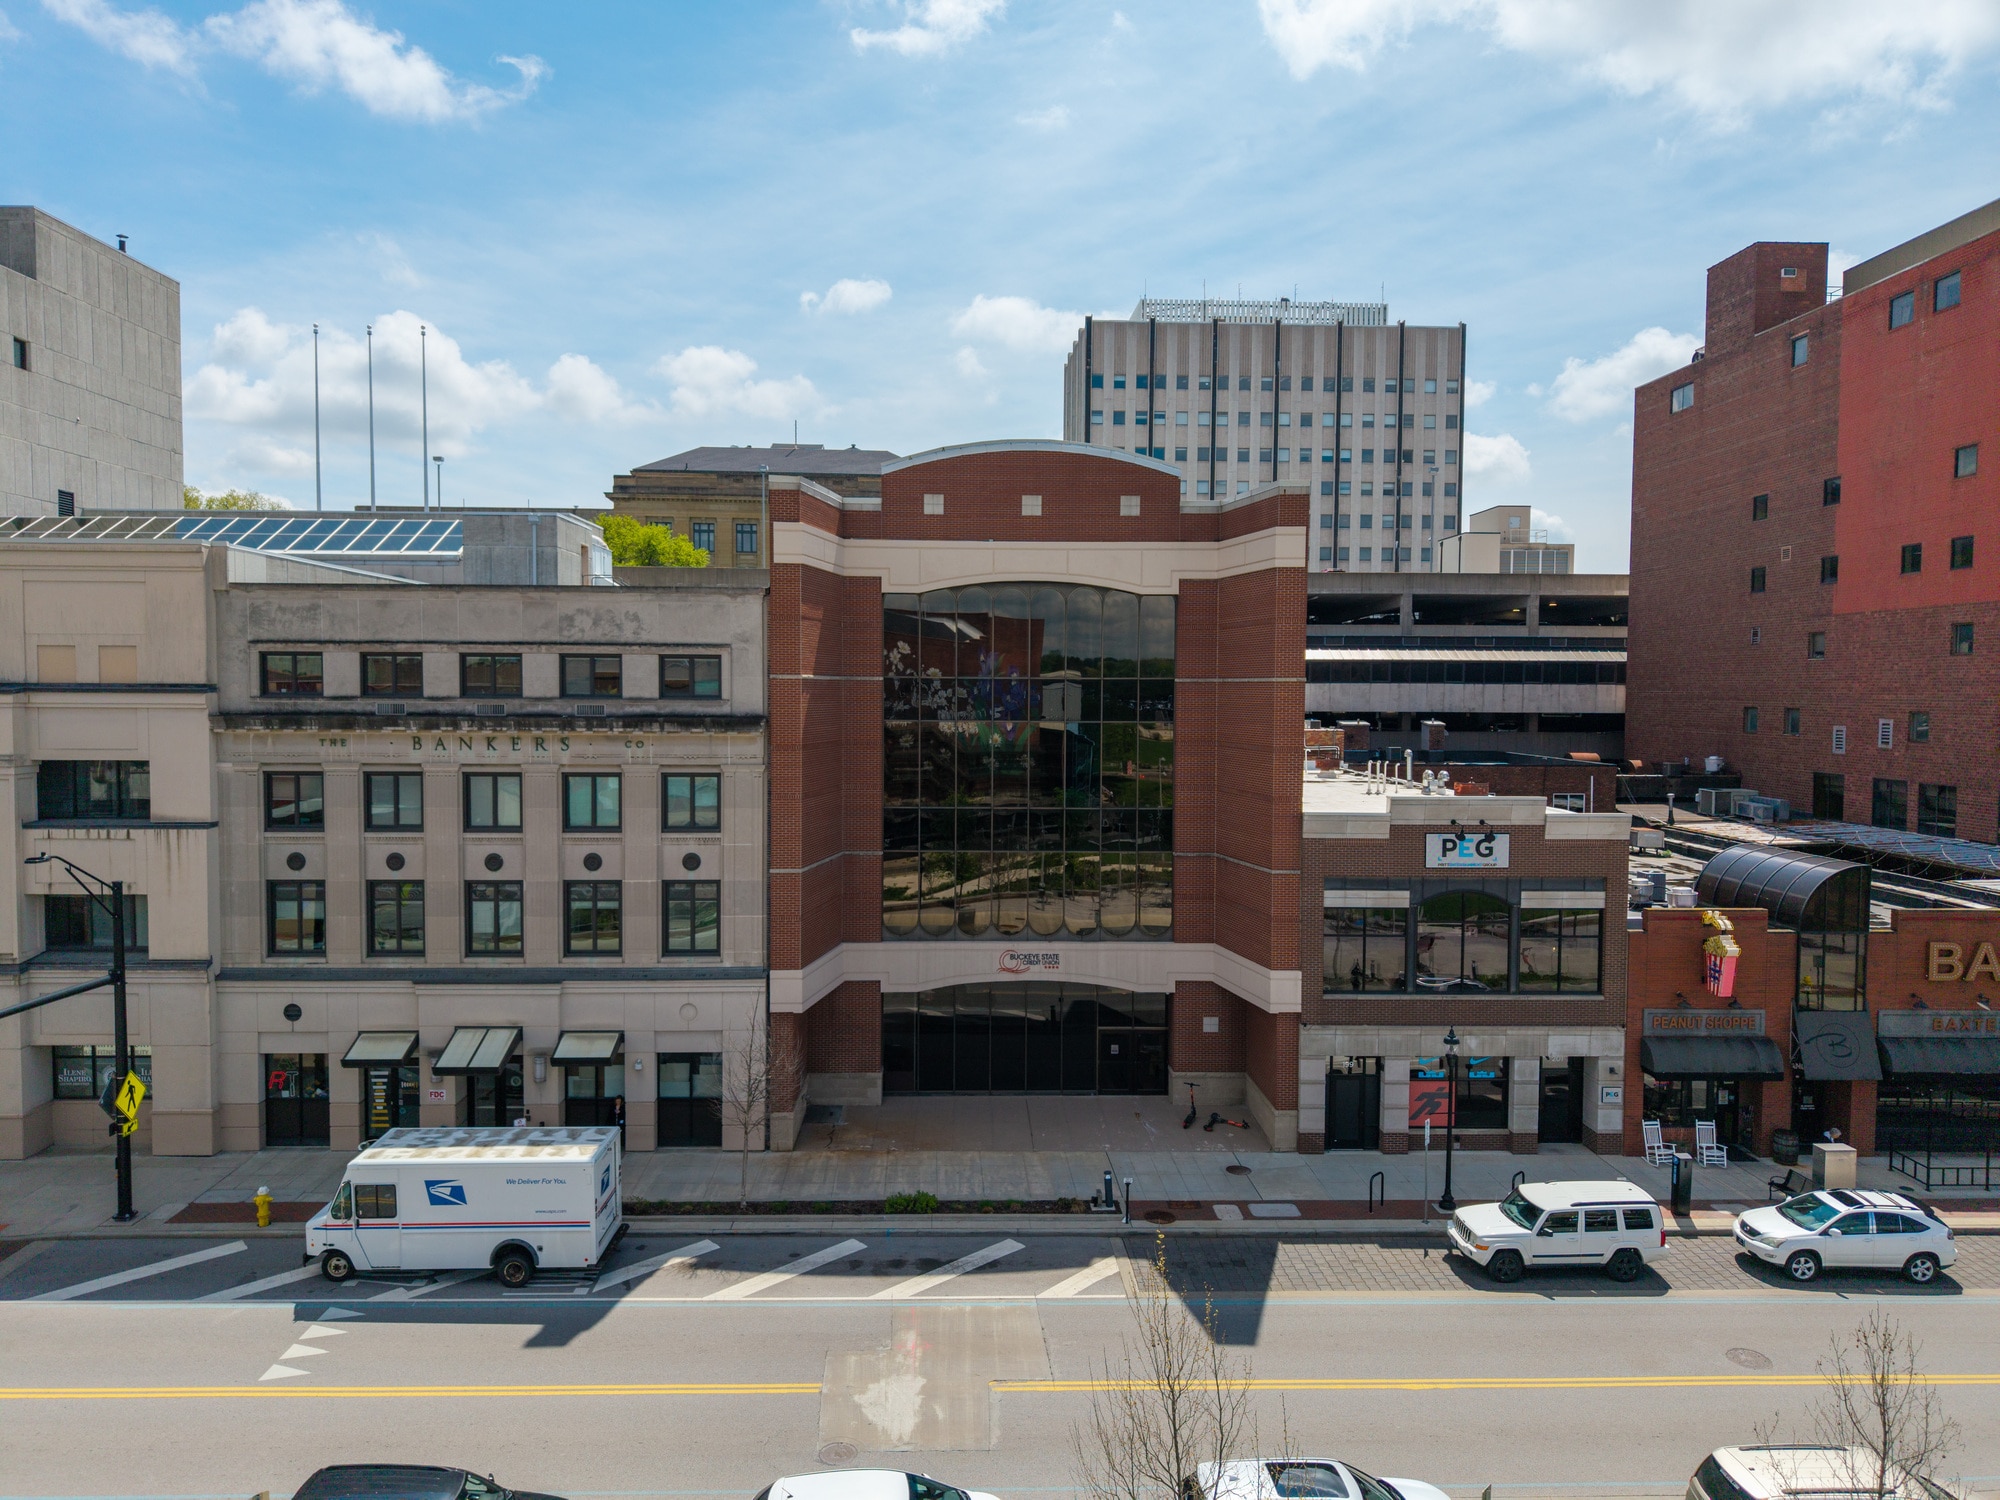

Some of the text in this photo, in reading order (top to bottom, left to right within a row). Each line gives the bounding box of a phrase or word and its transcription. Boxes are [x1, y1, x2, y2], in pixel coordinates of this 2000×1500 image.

[319, 738, 347, 747] THE
[412, 736, 570, 751] BANKERS
[1441, 838, 1494, 858] PEG
[1928, 942, 2000, 981] BA
[1653, 1016, 1756, 1029] PEANUT SHOPPE
[58, 1074, 92, 1082] SHAPIRO
[62, 1068, 87, 1076] ILENE
